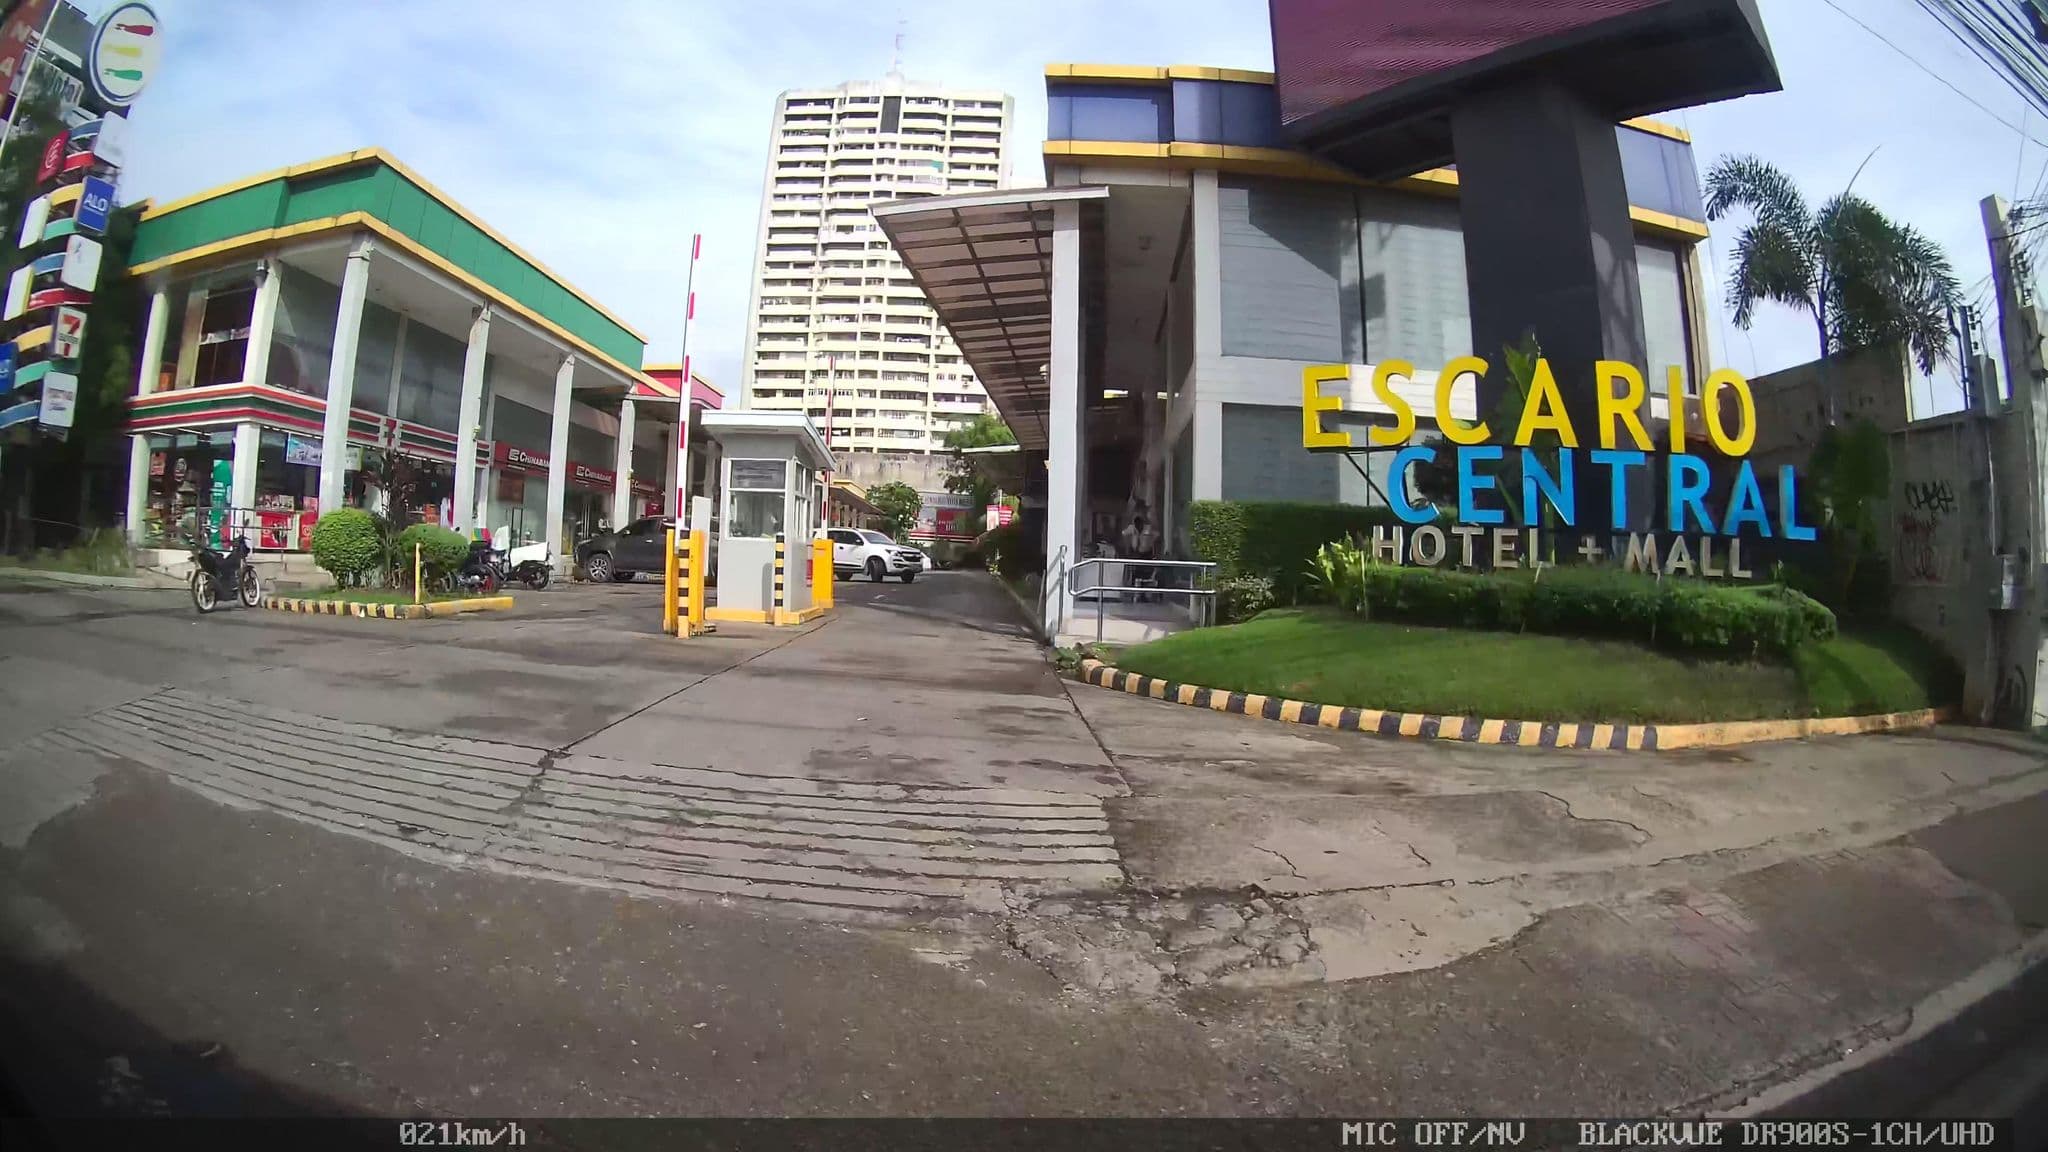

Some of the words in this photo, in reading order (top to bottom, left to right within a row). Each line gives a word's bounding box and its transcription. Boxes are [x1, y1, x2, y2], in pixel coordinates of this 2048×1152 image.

[1303, 356, 1757, 457] ESCARIO
[1387, 446, 1817, 541] CENTRAL
[1372, 524, 1556, 569] HOTEL
[1625, 532, 1754, 578] MALL
